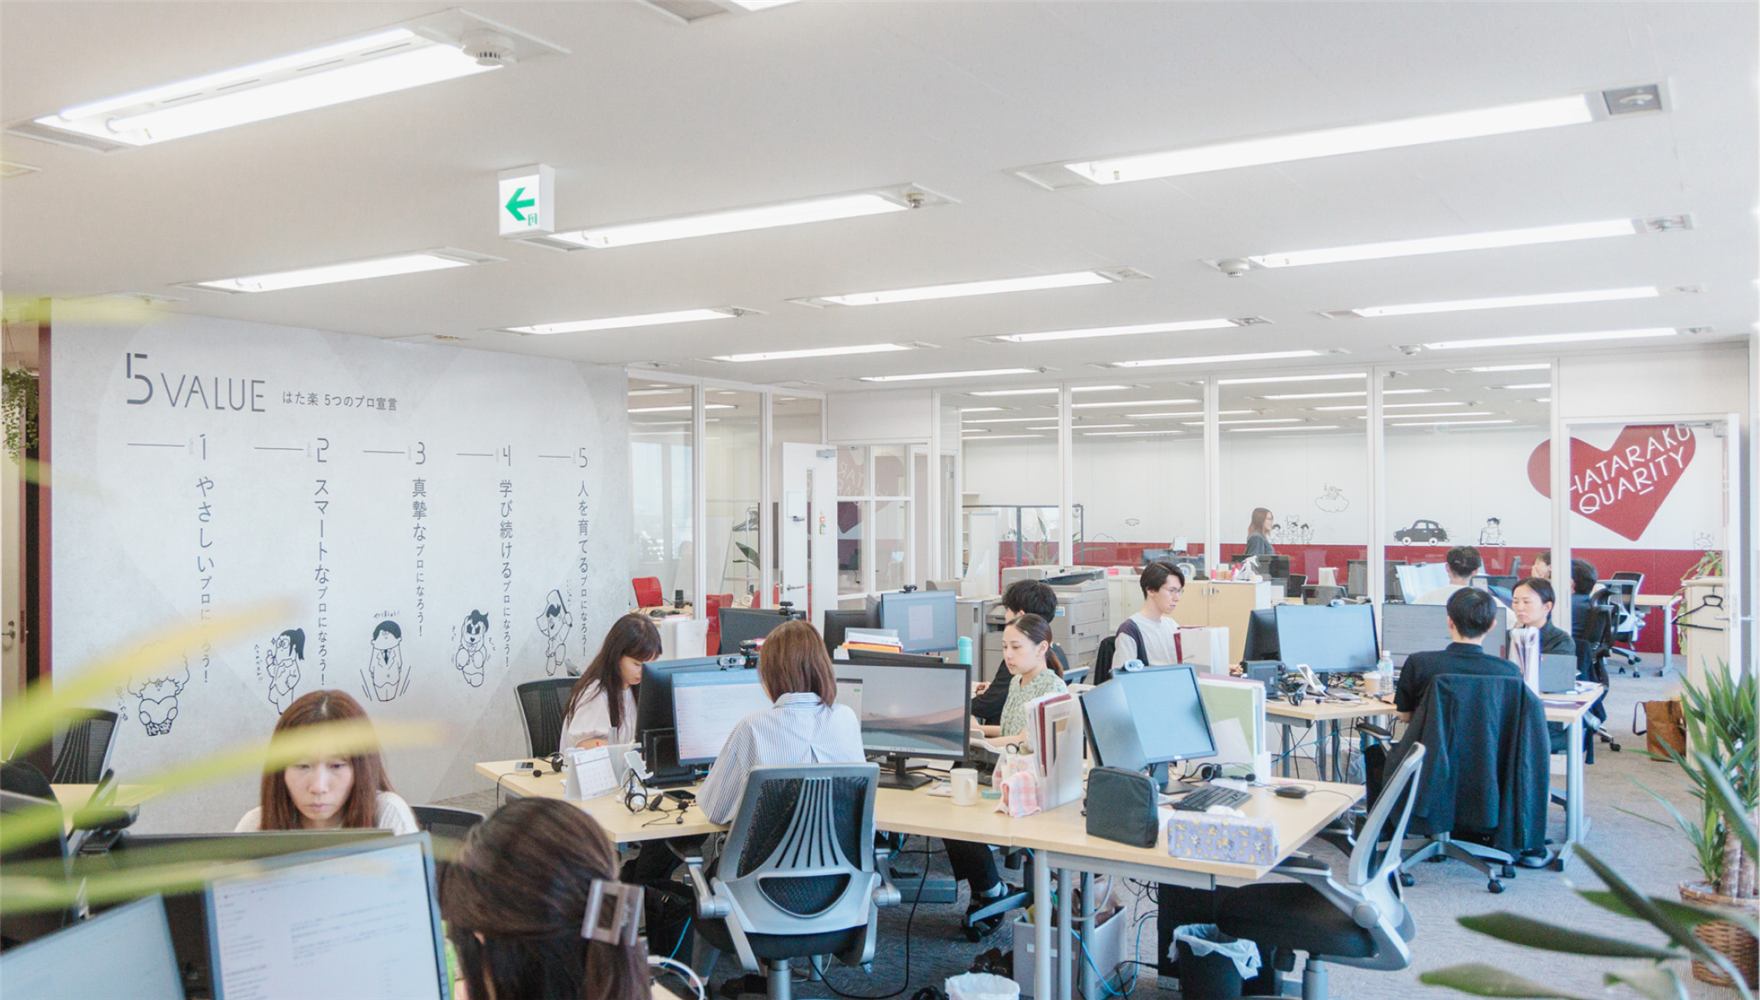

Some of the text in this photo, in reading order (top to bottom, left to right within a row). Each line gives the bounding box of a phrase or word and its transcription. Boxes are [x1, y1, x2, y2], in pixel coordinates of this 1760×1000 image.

[126, 352, 265, 413] 5 VALUE
[282, 390, 398, 411] はた楽 5つのプロ宣言
[199, 433, 207, 460] 1
[315, 437, 329, 463] 2
[415, 441, 426, 466] 3
[502, 444, 511, 467] 4
[578, 447, 589, 468] 5
[1578, 445, 1685, 515] QUARITY
[196, 476, 214, 684] やさしいプロにろう！
